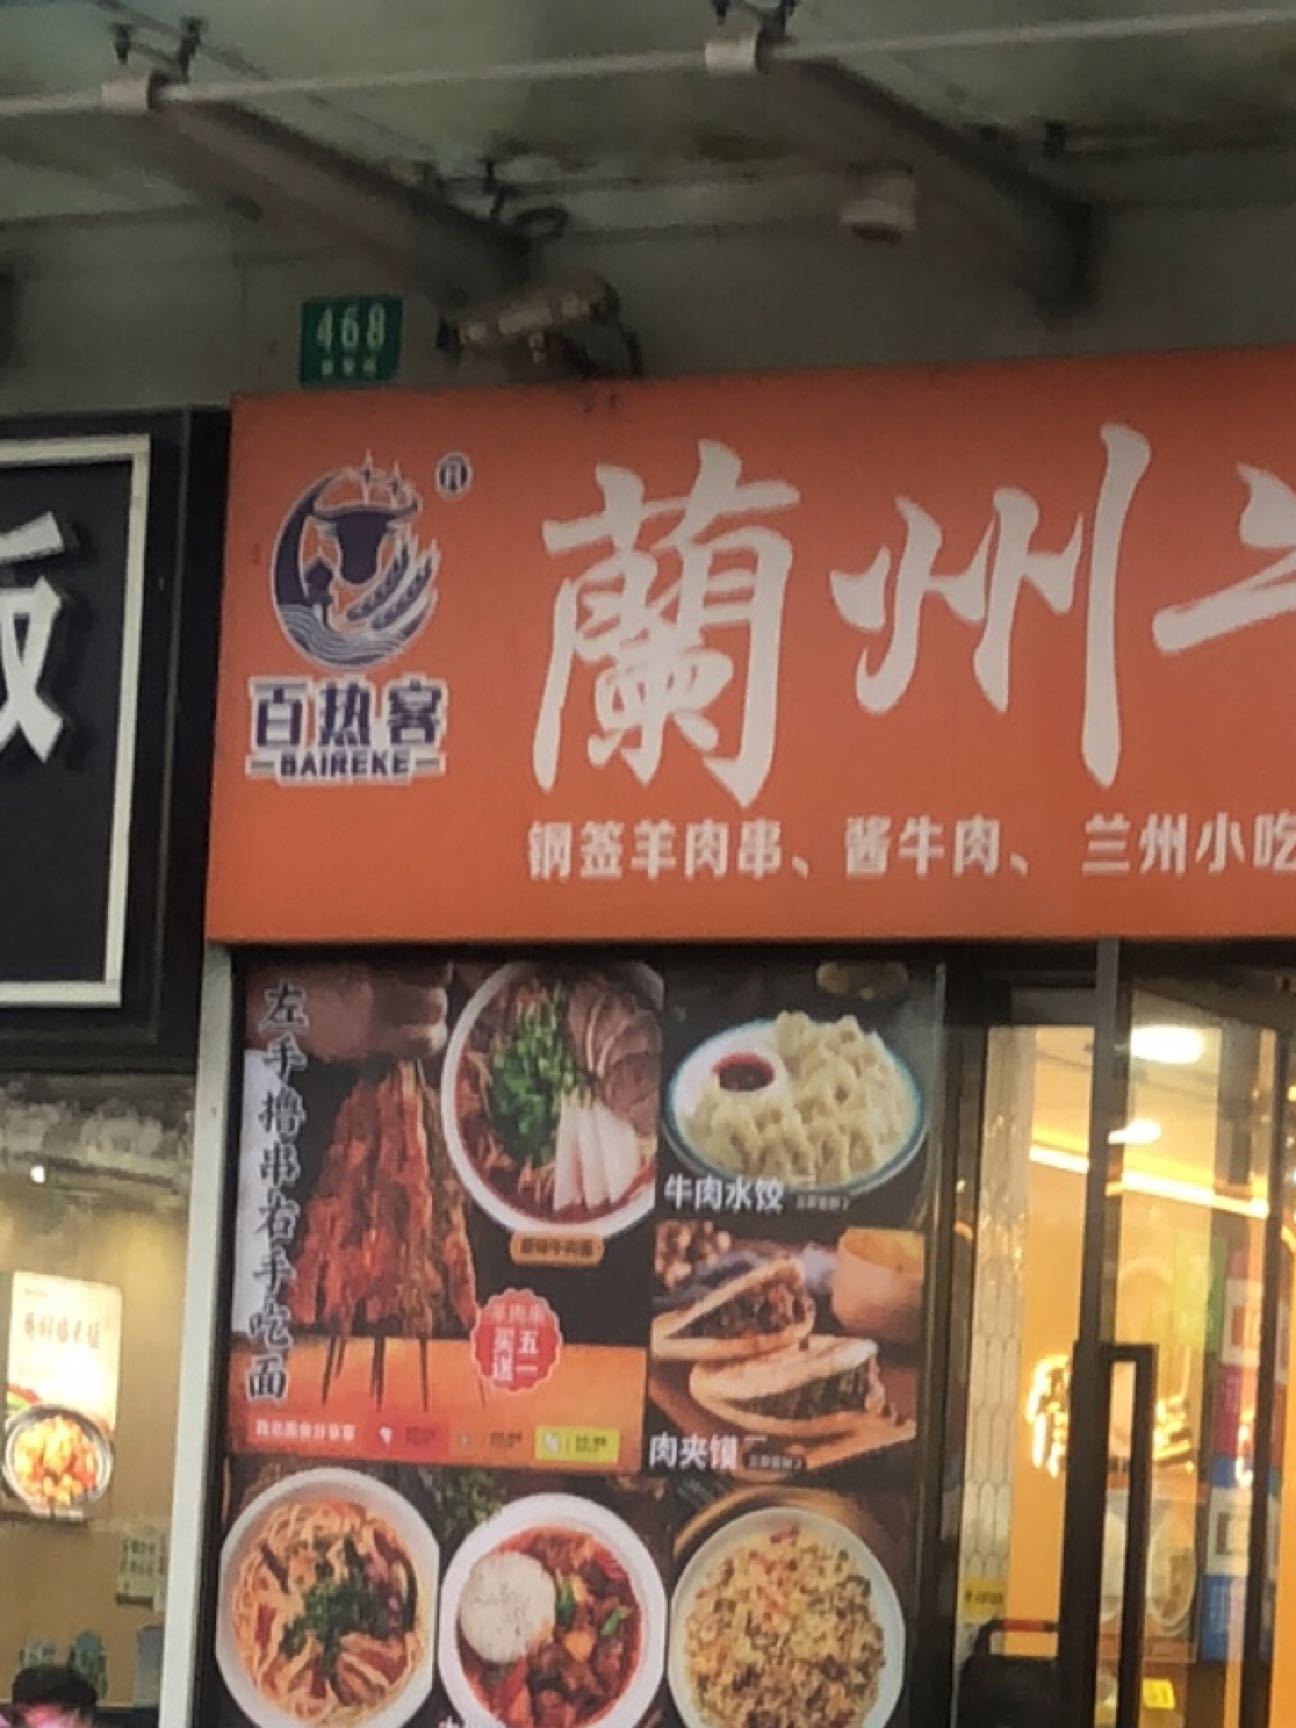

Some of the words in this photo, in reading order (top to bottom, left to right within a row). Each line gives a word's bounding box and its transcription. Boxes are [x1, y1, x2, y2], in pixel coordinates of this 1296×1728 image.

[315, 303, 385, 352] 468
[252, 676, 445, 748] 百热客
[280, 750, 411, 777] BAIREKE
[664, 1172, 785, 1213] 牛肉水饺
[648, 1432, 738, 1471] 肉夹馍
